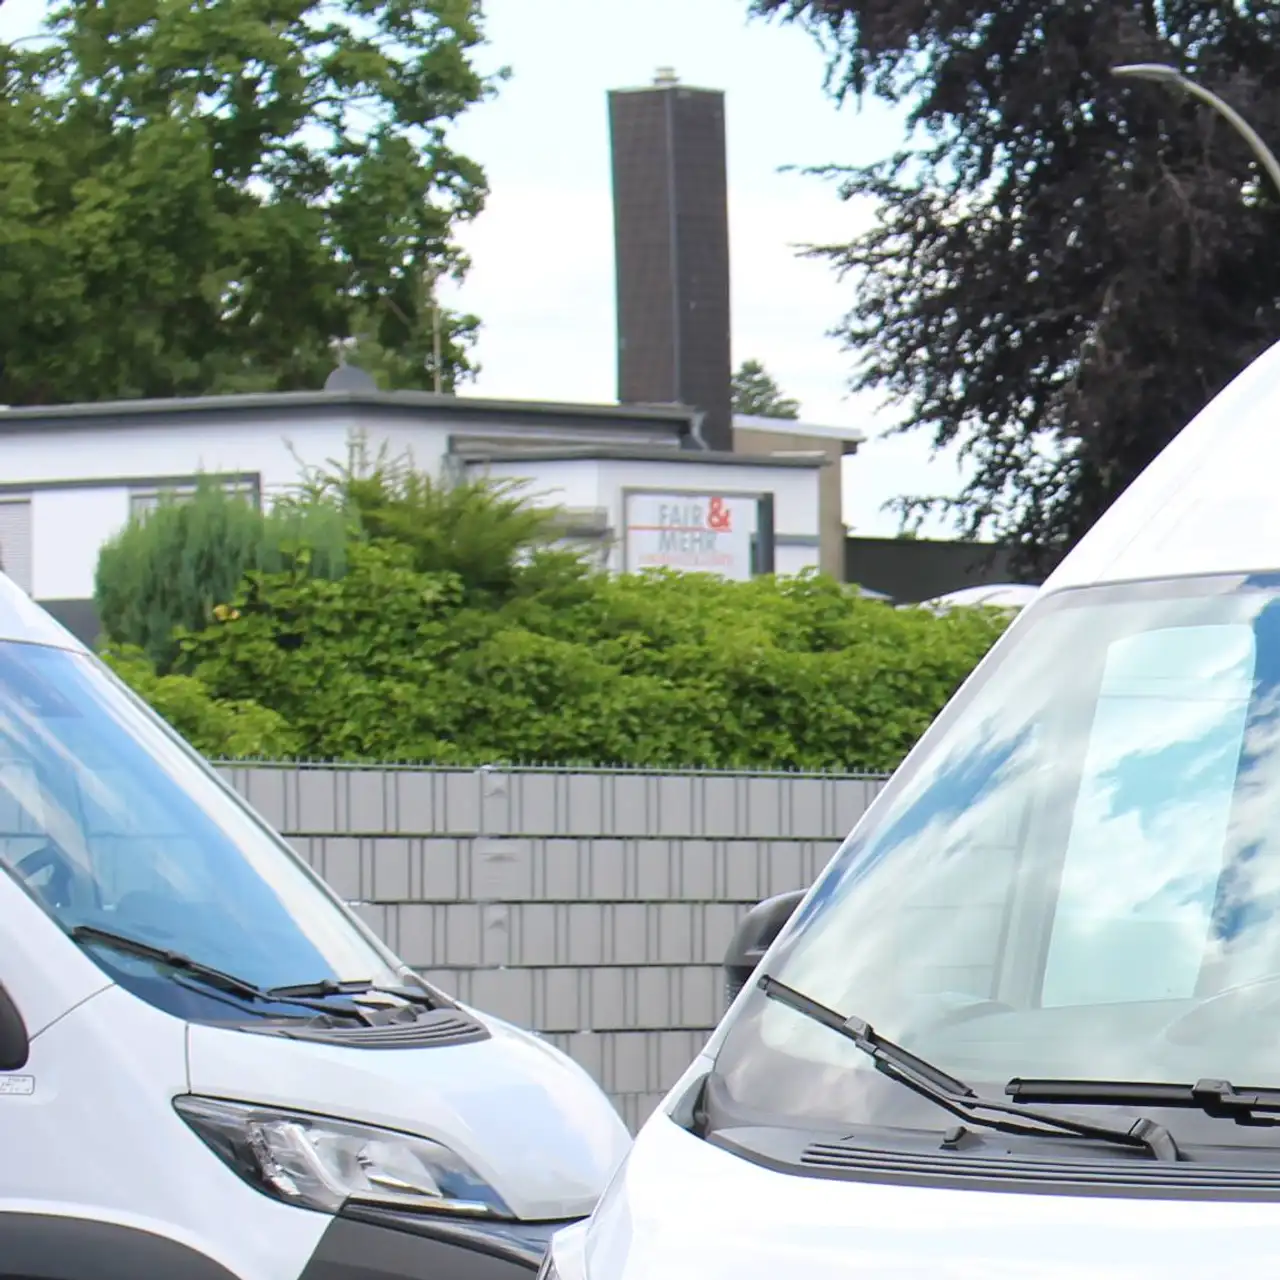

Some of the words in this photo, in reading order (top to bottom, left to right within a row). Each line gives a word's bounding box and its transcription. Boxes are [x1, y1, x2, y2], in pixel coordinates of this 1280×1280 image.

[660, 504, 703, 526] FAIR
[707, 496, 732, 532] &
[660, 531, 716, 552] MEHR
